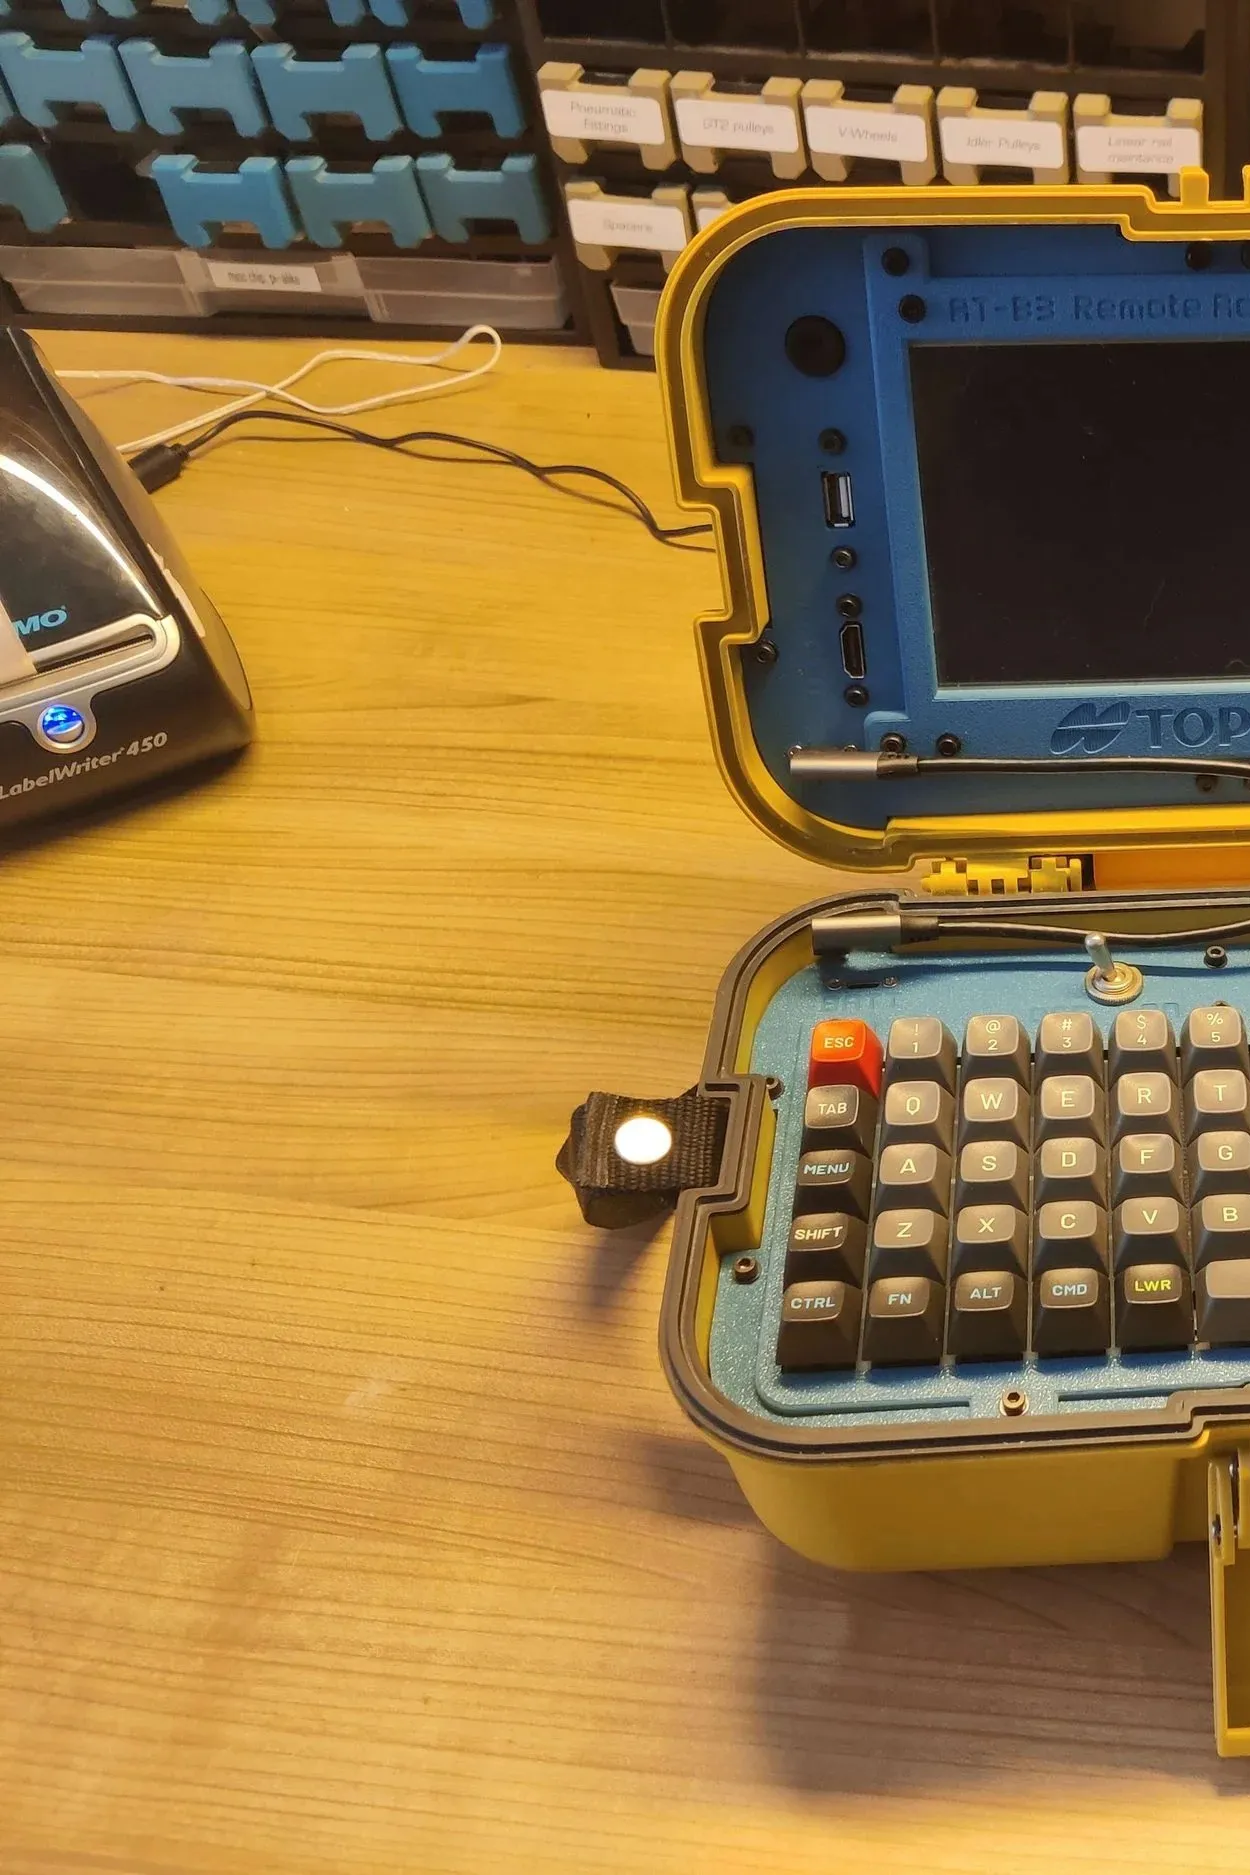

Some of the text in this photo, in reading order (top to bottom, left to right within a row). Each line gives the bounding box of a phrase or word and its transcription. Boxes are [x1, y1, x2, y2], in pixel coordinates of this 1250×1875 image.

[732, 119, 775, 135] pulleys
[997, 138, 1041, 153] Pulleys
[1073, 294, 1202, 321] Remote
[0, 732, 168, 800] LabelWriter 450
[824, 1036, 854, 1047] ESC
[1062, 1036, 1072, 1048] 3
[1136, 1034, 1147, 1045] 4
[1211, 1031, 1221, 1043] 5
[912, 1040, 919, 1054] 1
[987, 1039, 998, 1051] 2
[1061, 1091, 1075, 1108] E
[1137, 1087, 1152, 1104] R
[1213, 1085, 1227, 1102] T
[818, 1102, 848, 1115] TAB
[905, 1097, 921, 1115] Q
[980, 1093, 1003, 1110] W
[1061, 1151, 1076, 1168] D
[1140, 1149, 1154, 1165] F
[1217, 1145, 1233, 1161] G
[803, 1162, 850, 1176] MENU
[900, 1159, 917, 1174] A
[982, 1155, 996, 1171] S
[1061, 1214, 1076, 1229] C
[1143, 1210, 1158, 1225] V
[1223, 1207, 1238, 1222] B
[896, 1222, 912, 1238] Z
[979, 1217, 994, 1233] X
[794, 1226, 843, 1240] SHIFT
[970, 1286, 1001, 1299] ALT
[1052, 1283, 1087, 1295] CMD
[1134, 1279, 1171, 1292] LWR
[791, 1296, 836, 1309] CTRL
[888, 1292, 912, 1305] FN
